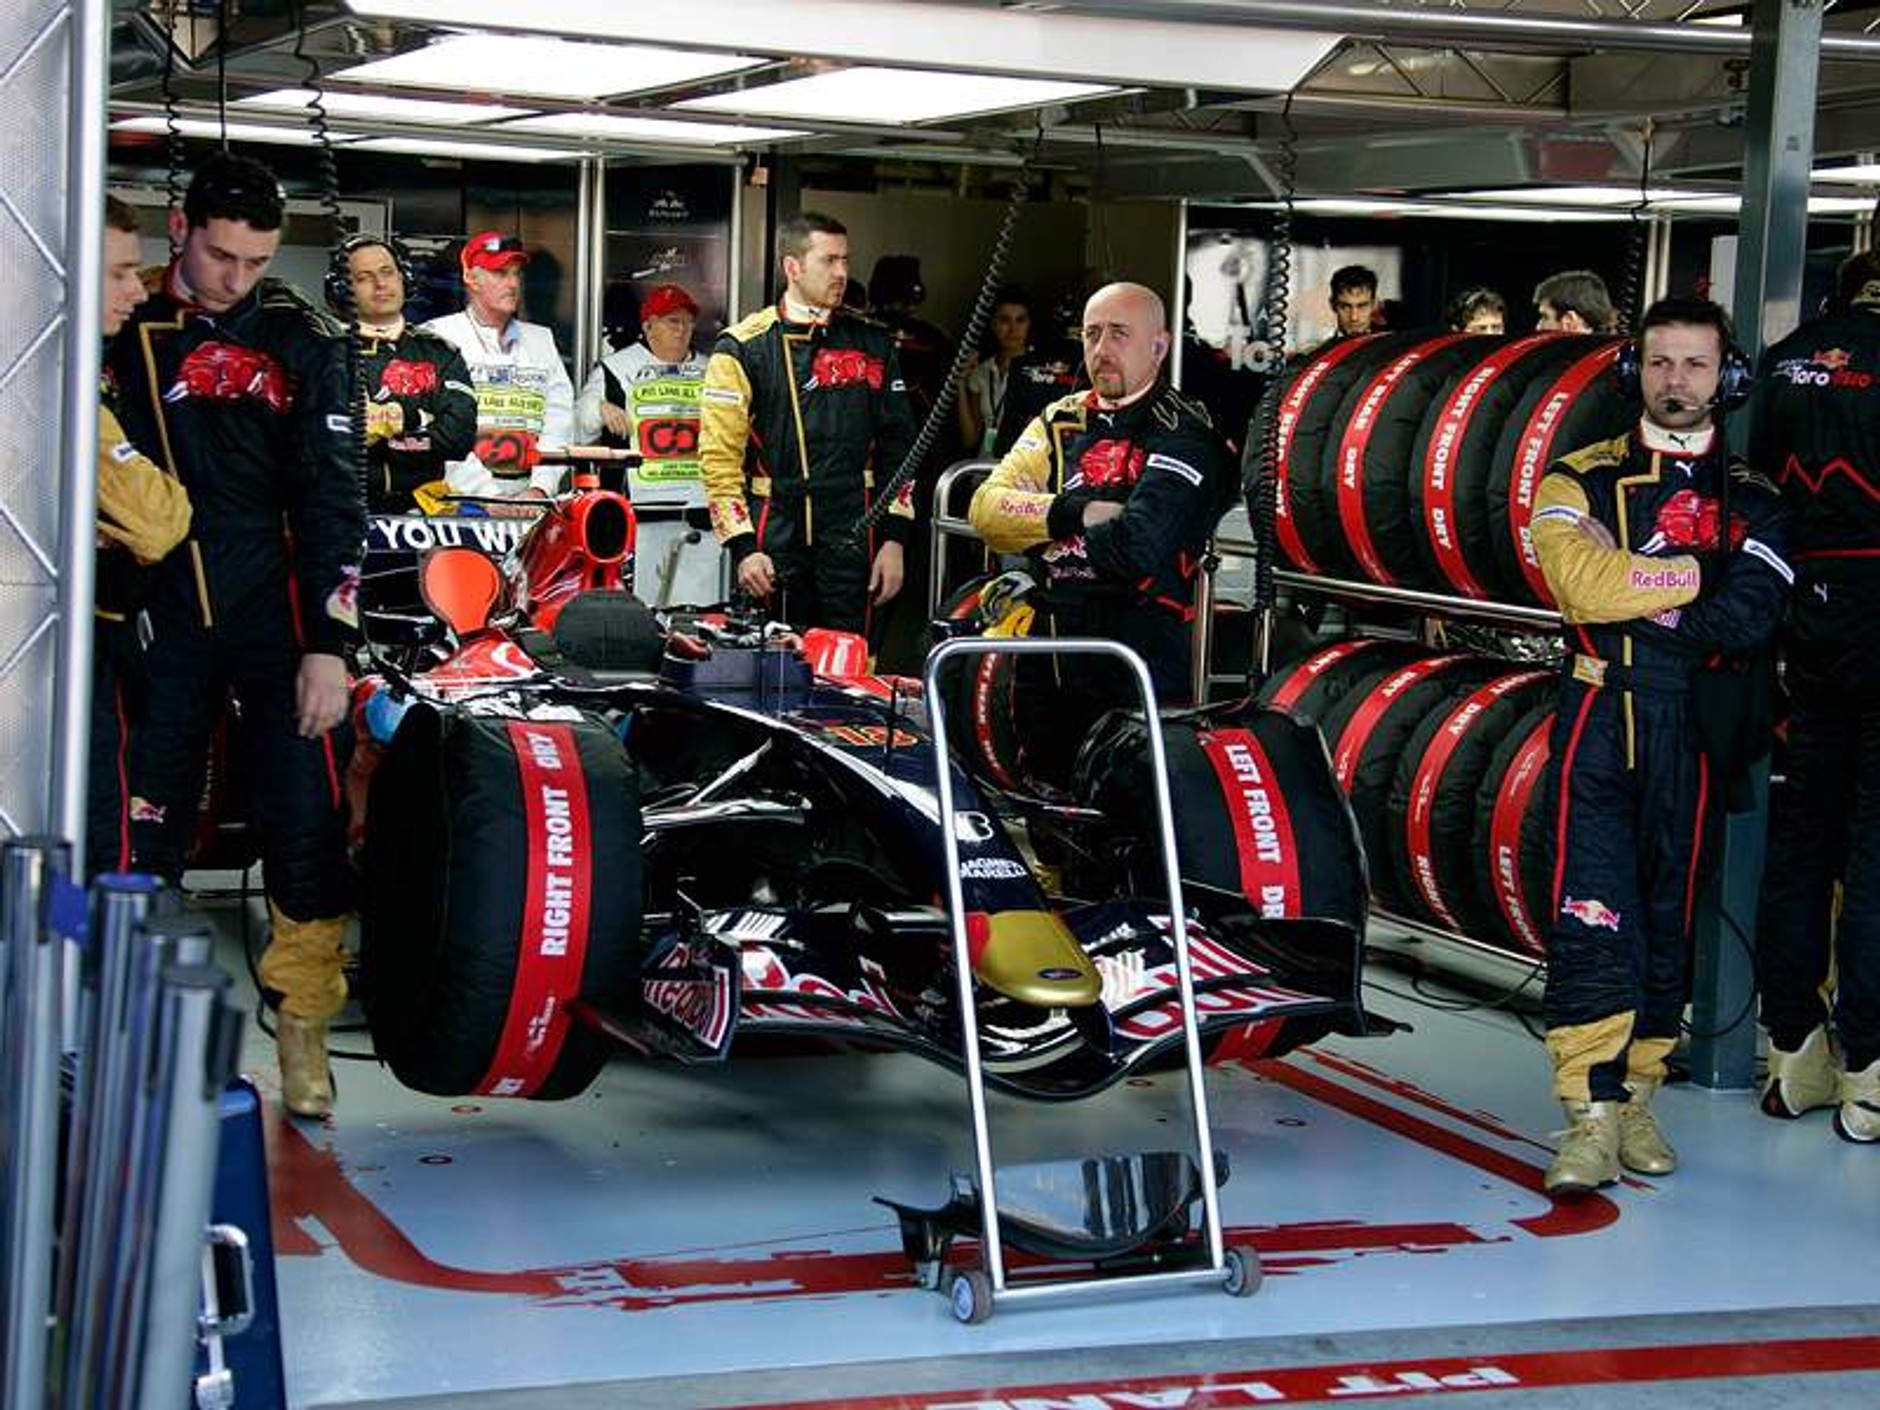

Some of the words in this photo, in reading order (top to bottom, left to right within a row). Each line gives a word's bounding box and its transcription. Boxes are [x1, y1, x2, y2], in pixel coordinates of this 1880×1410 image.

[1450, 366, 1496, 418] RIGHT
[1537, 392, 1570, 433] LEFT
[1344, 447, 1358, 489] DRY
[1431, 424, 1458, 490] FRONT
[1518, 438, 1542, 508] FRONT
[376, 518, 463, 550] YOU
[1432, 507, 1452, 550] DRY
[1520, 526, 1539, 567] DRY
[1309, 650, 1343, 673] DRY
[1382, 671, 1418, 698] DRY
[1450, 702, 1482, 735] DRY
[529, 733, 553, 770] DRY
[1224, 743, 1261, 784] LEFT
[545, 786, 573, 867] FRONT
[1243, 789, 1282, 864] FRONT
[1499, 846, 1515, 893] LEFT
[539, 875, 573, 957] RIGHT
[1260, 885, 1285, 919] DR
[1327, 1367, 1520, 1396] PIT
